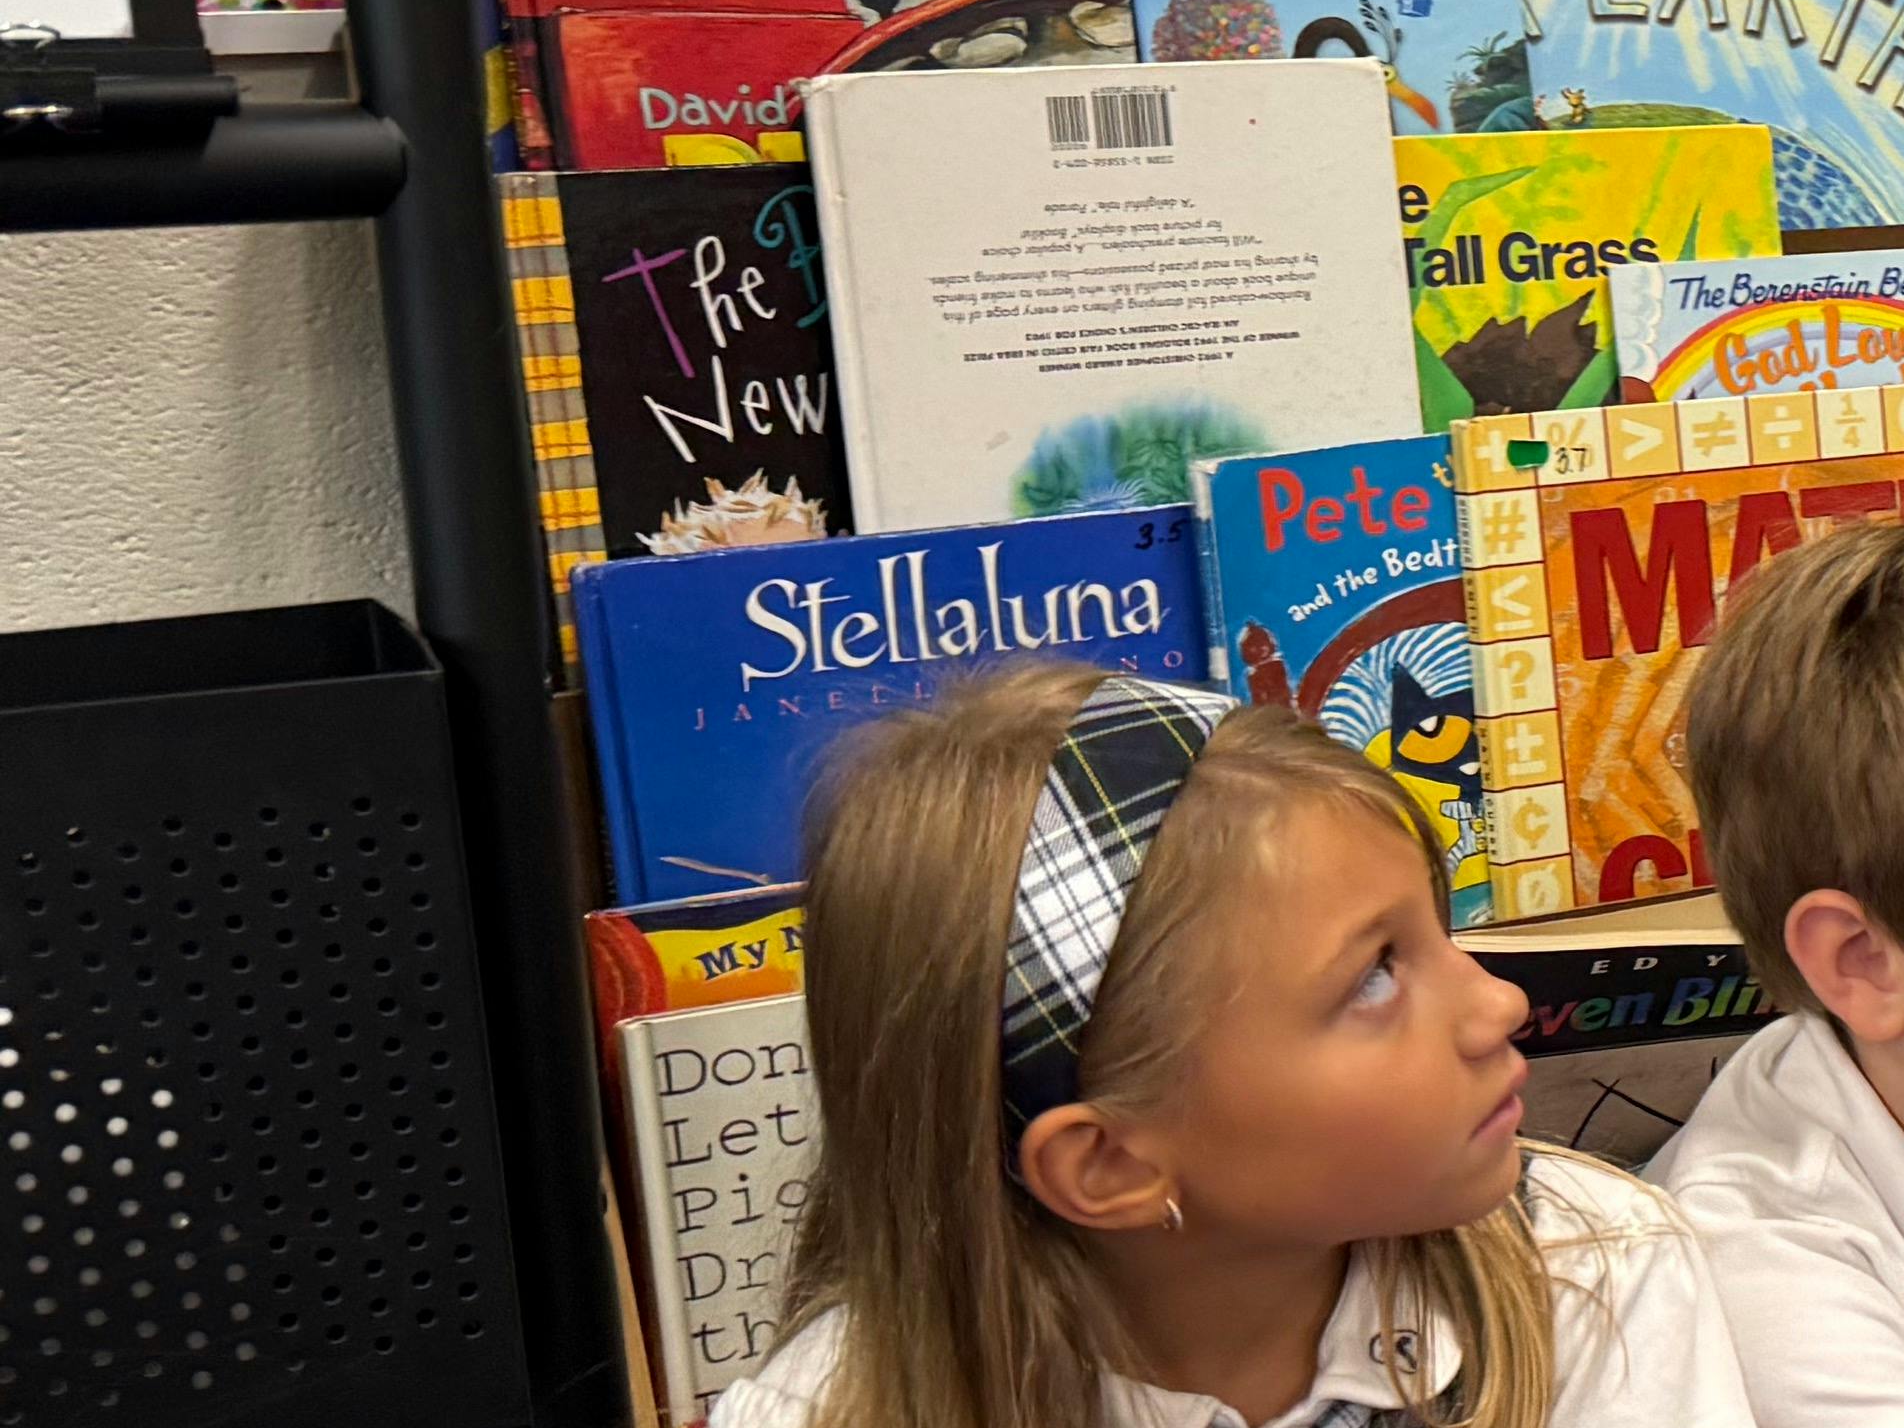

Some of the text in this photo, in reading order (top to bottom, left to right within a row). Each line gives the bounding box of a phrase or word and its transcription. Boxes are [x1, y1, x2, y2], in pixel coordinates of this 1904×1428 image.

[639, 83, 788, 130] David
[1402, 231, 1660, 289] Tall Grass
[601, 235, 776, 377] The
[1670, 274, 1725, 311] The
[1729, 271, 1871, 307] Berenstain
[1713, 318, 1819, 397] God
[643, 354, 827, 463] New
[1257, 466, 1432, 553] Pete
[740, 540, 1171, 693] Stellaluna
[1287, 583, 1333, 622] and
[1333, 569, 1378, 598] the
[694, 938, 768, 983] My
[1590, 957, 1658, 975] ED
[663, 1104, 808, 1169] Let
